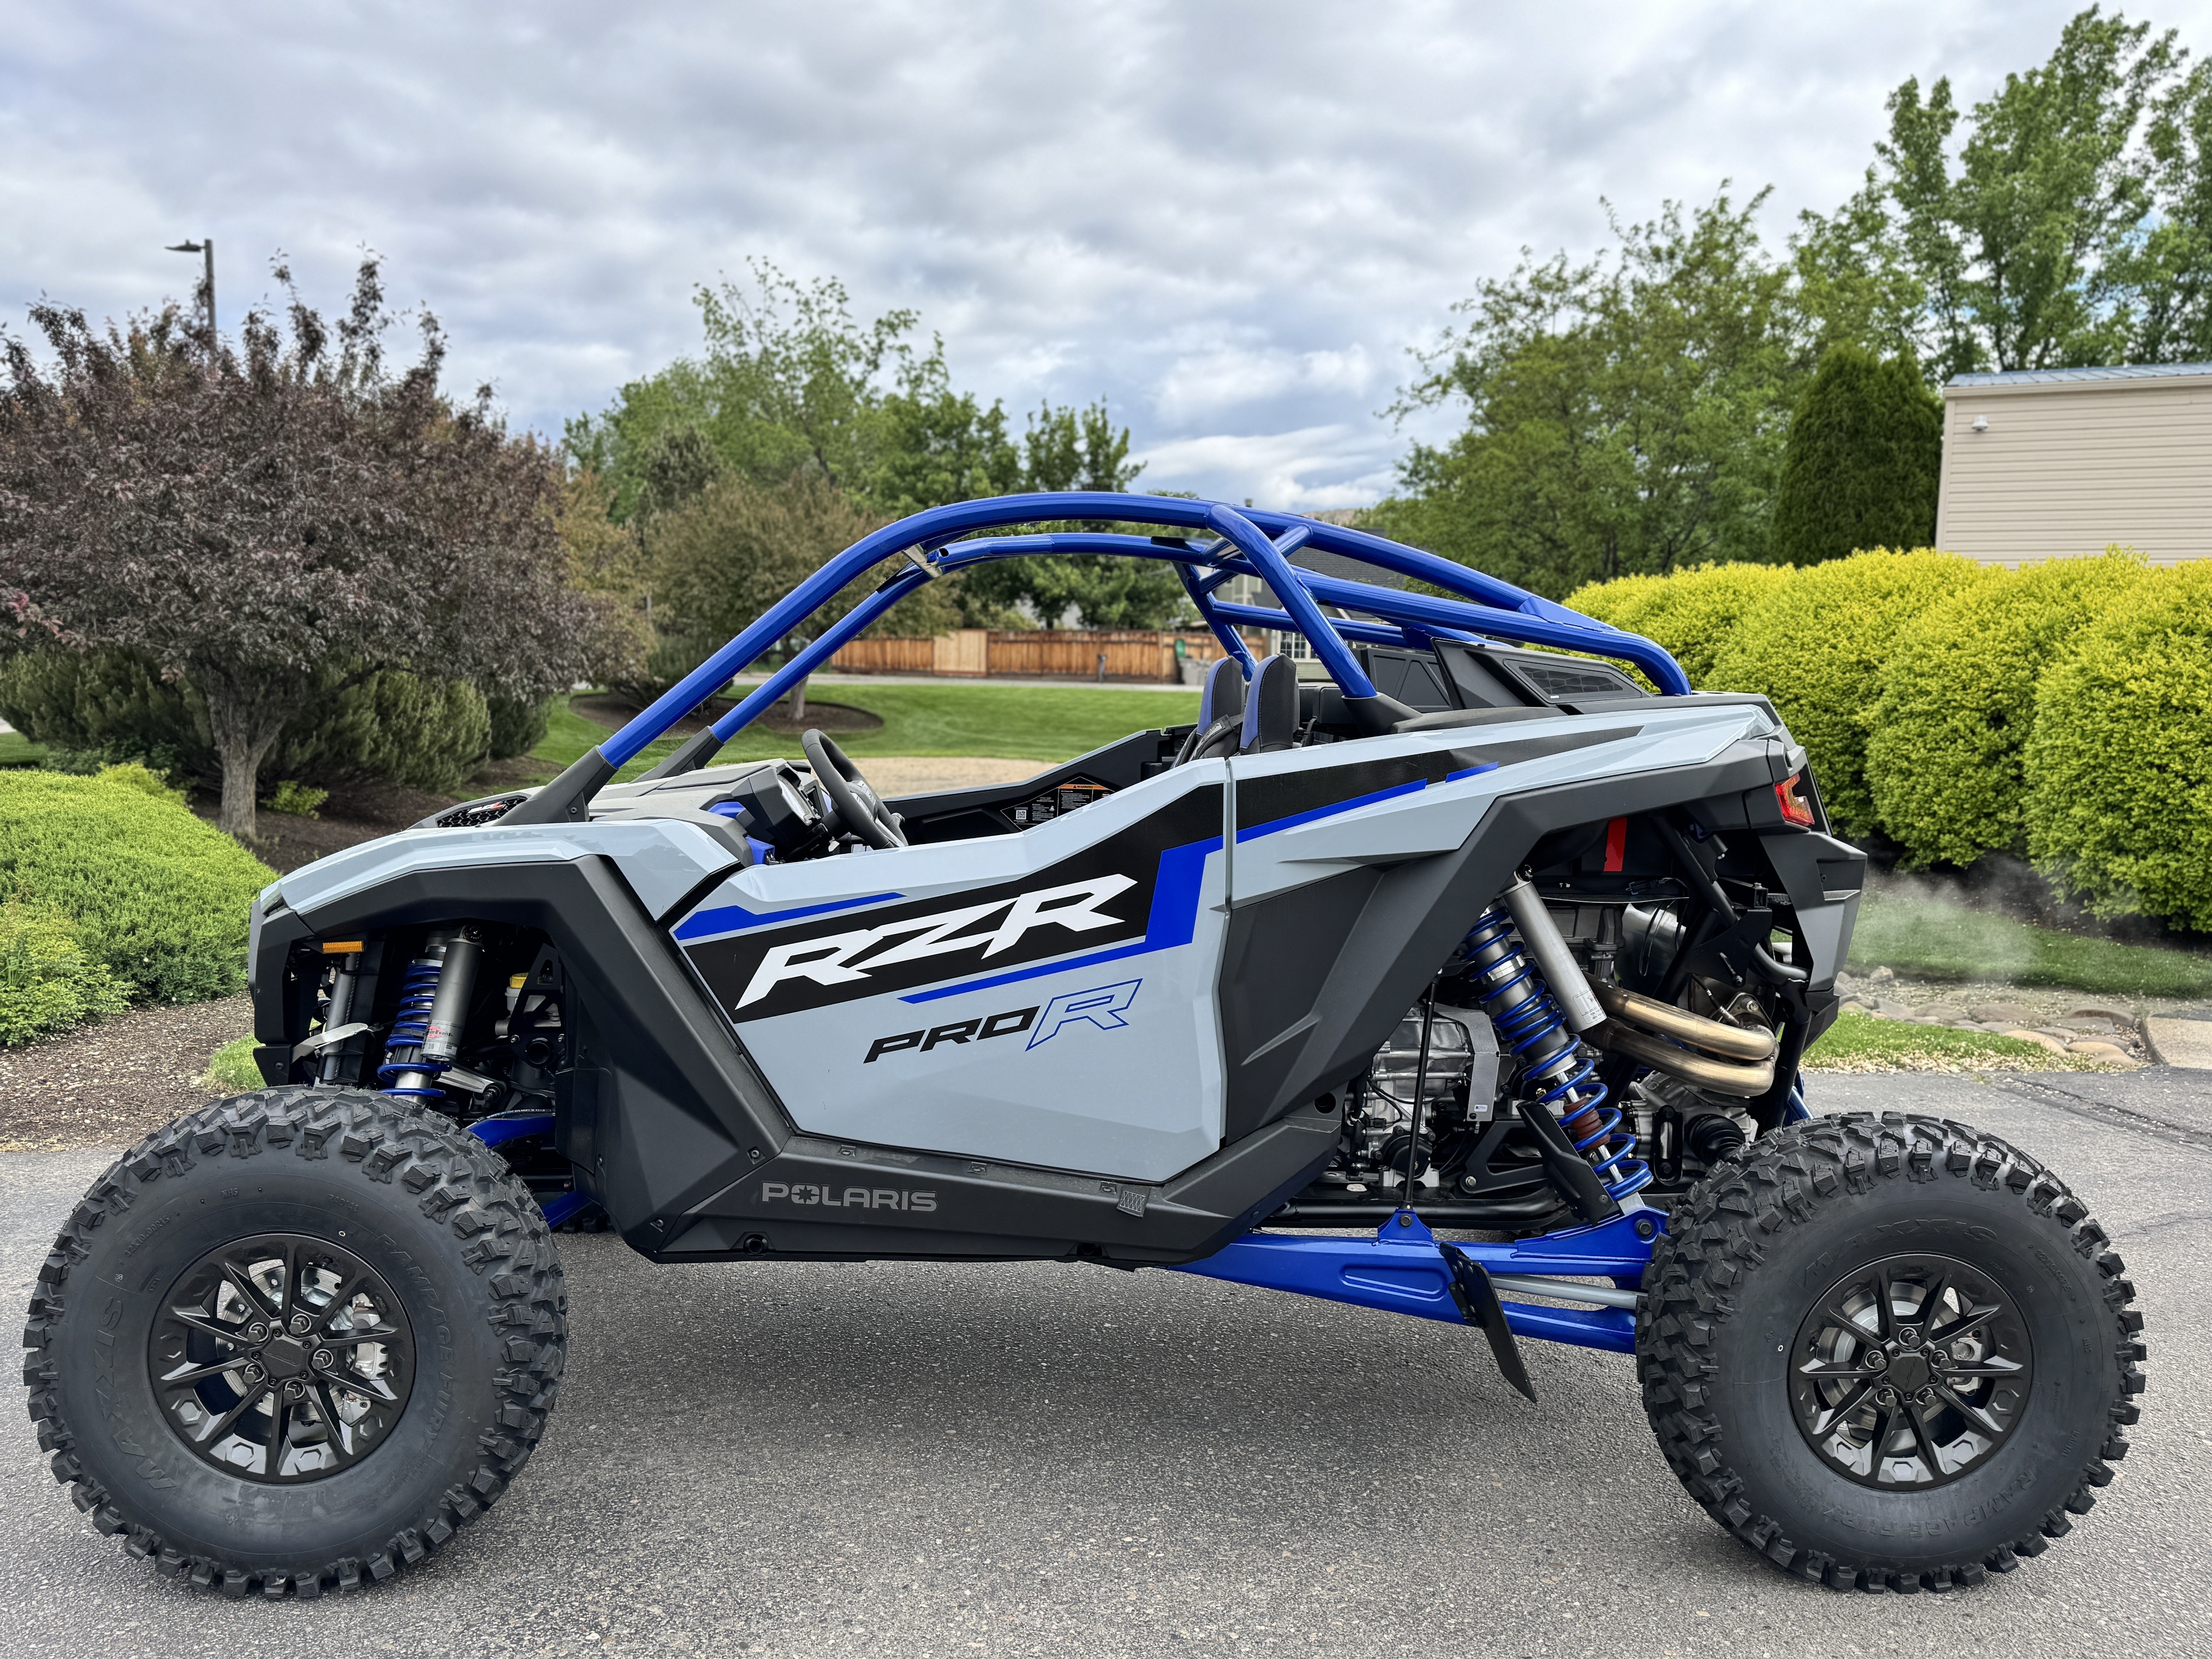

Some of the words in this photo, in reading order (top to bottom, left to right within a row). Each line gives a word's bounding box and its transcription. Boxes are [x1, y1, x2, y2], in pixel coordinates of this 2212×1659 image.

[735, 874, 1138, 1010] RZR
[863, 1006, 1041, 1064] PRO
[1026, 978, 1143, 1051] R
[761, 1180, 939, 1212] POLARIS
[93, 1297, 177, 1489] MAXXIS
[1908, 1468, 2037, 1537] RAMPAGE
